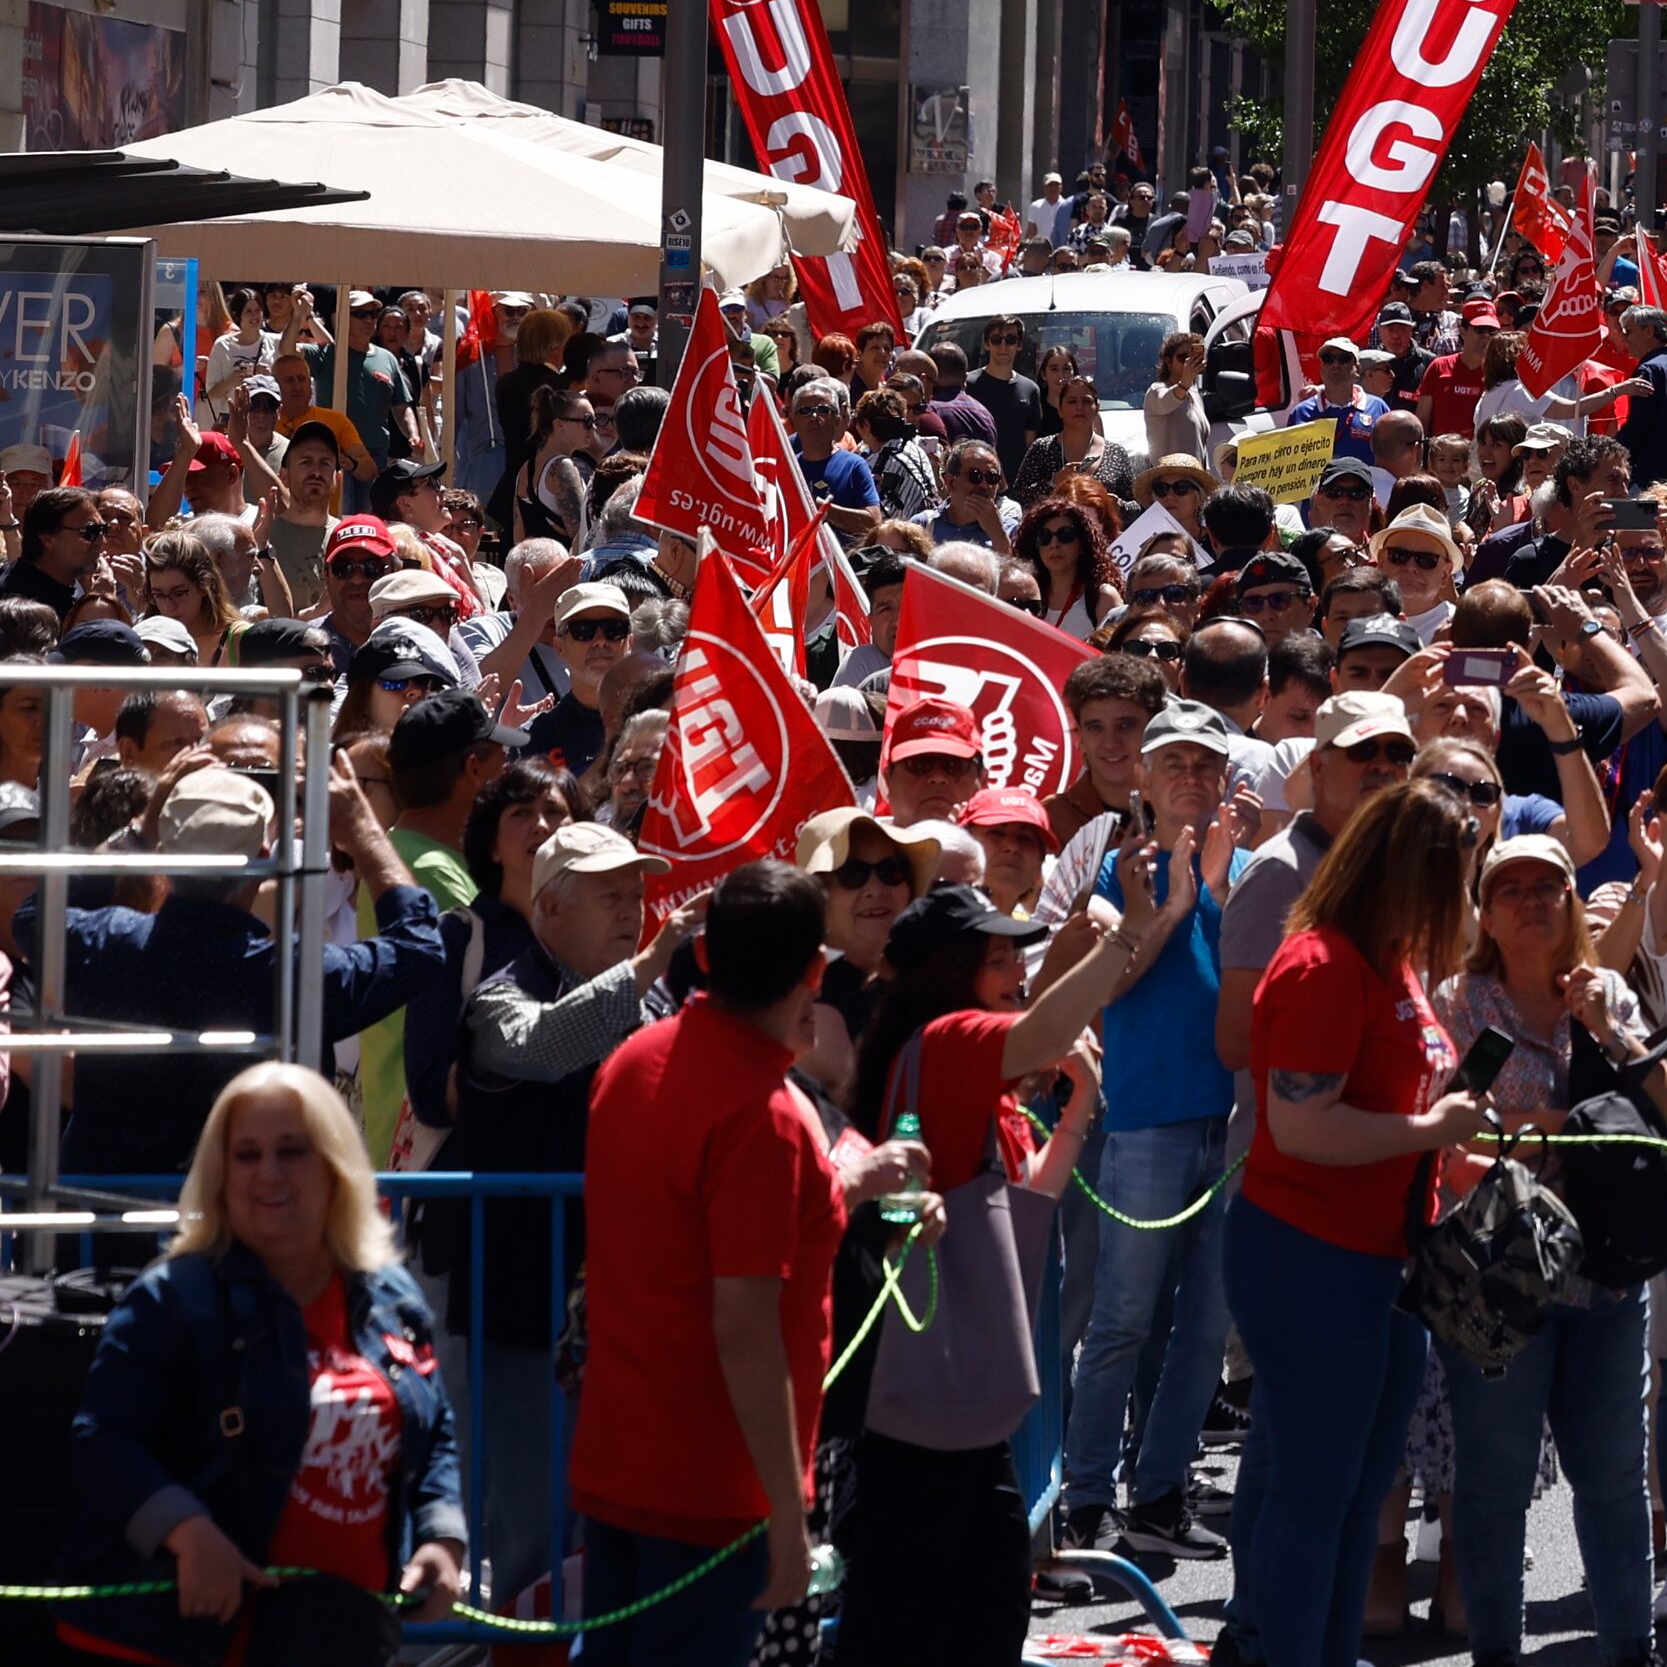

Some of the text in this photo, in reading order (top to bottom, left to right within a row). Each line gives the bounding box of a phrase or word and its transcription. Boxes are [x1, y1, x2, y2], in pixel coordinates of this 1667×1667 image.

[622, 17, 653, 31] GIFTS
[13, 372, 97, 391] KENZO
[1453, 386, 1471, 395] UGT
[1240, 455, 1260, 469] Para
[1300, 434, 1331, 455] ejército
[1268, 464, 1284, 479] hay
[1286, 465, 1297, 475] un
[1298, 457, 1327, 472] dinero
[1276, 477, 1307, 498] pensión,
